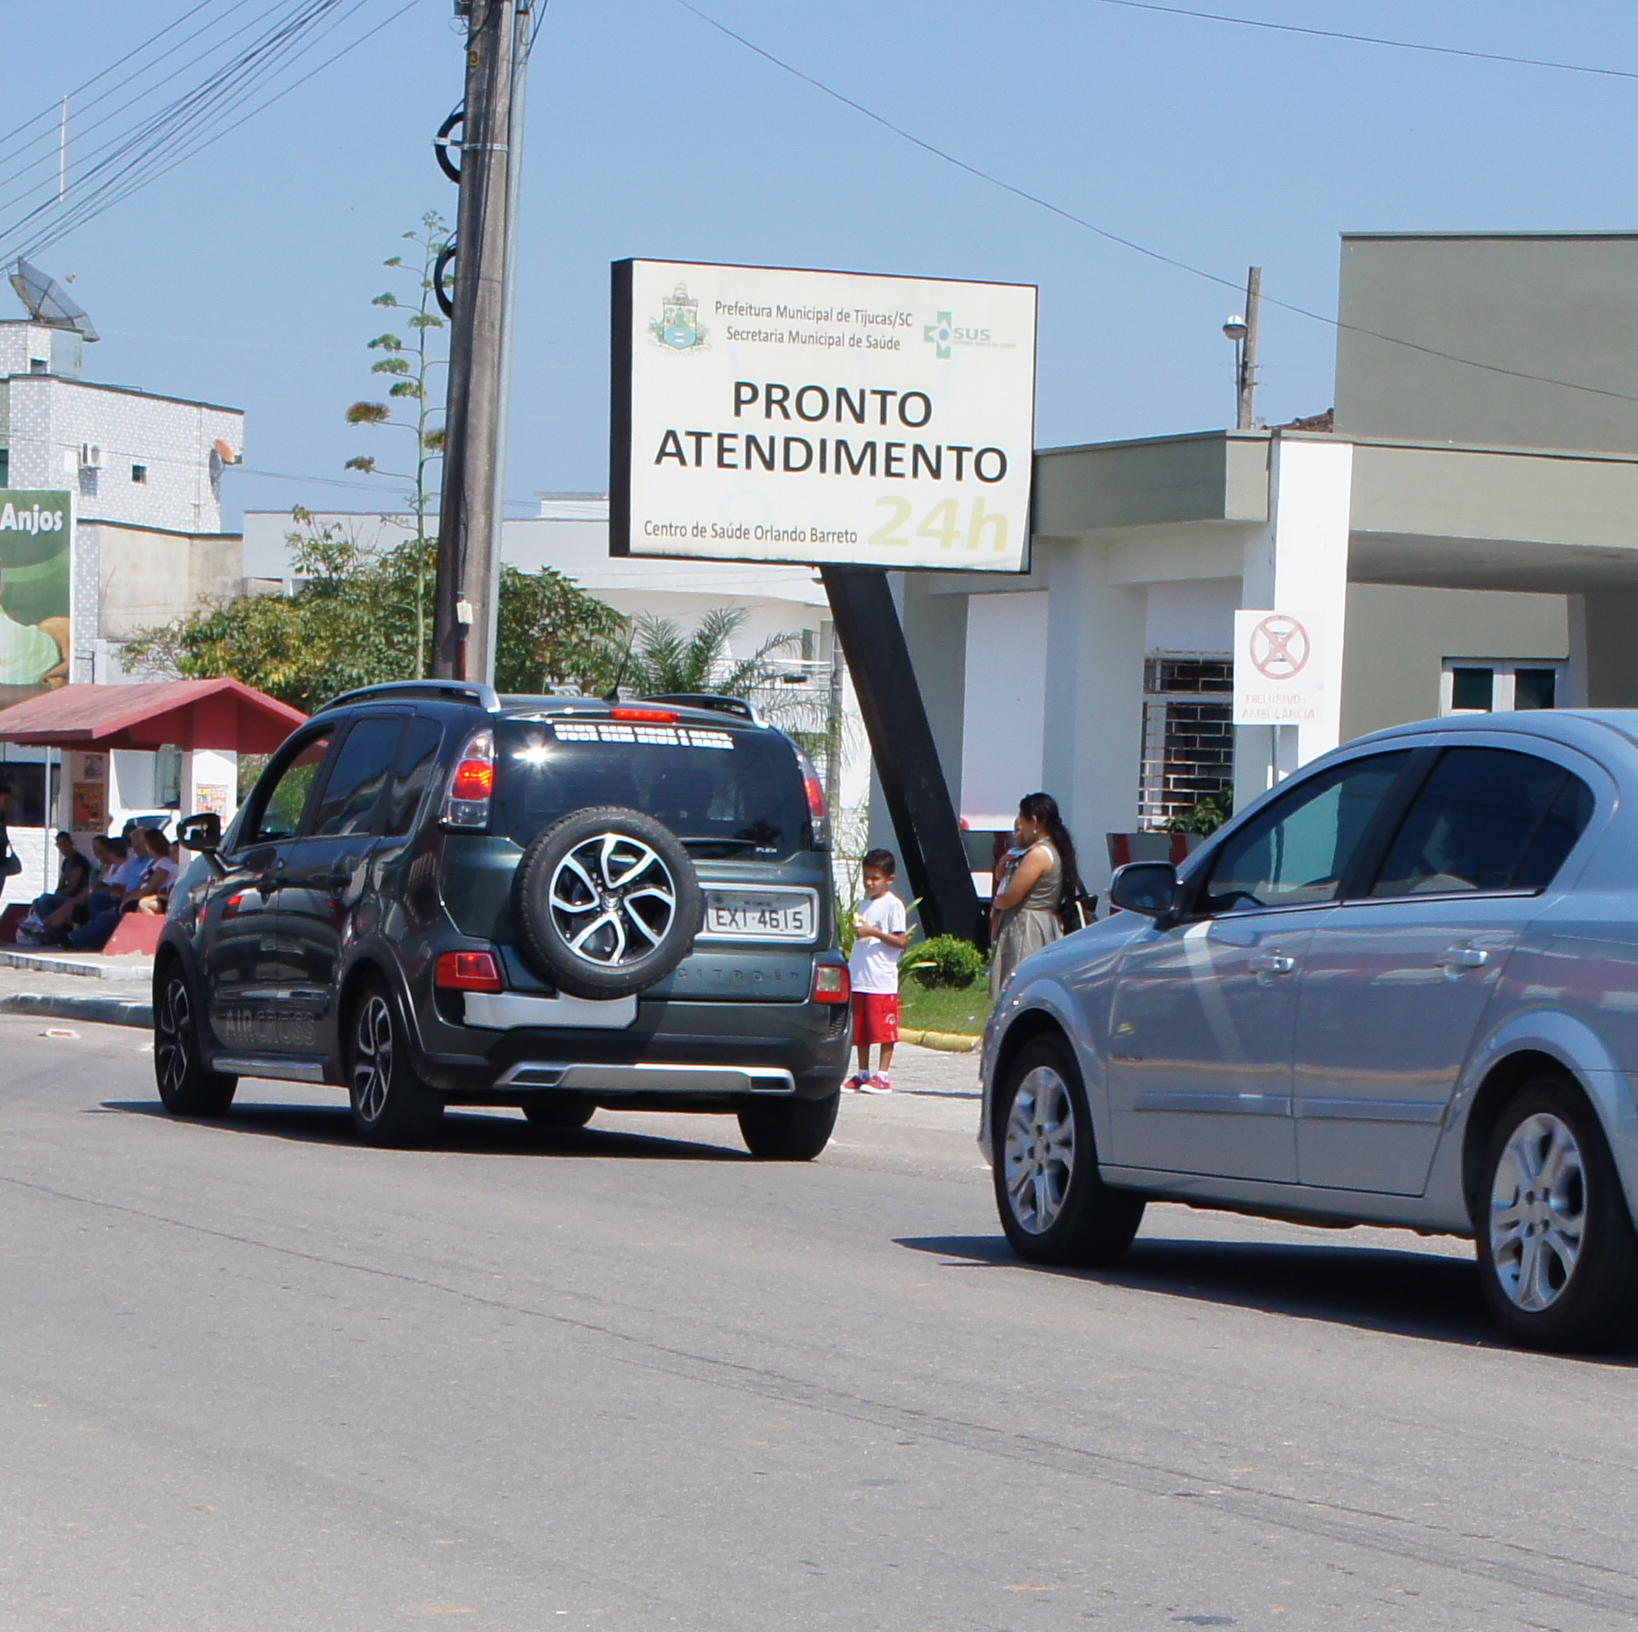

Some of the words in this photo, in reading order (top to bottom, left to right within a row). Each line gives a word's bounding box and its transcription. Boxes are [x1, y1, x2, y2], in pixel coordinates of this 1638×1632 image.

[715, 300, 772, 318] Prefeitura
[776, 304, 833, 324] Municipal
[836, 308, 851, 323] de
[854, 309, 913, 328] Tijucas/SC
[727, 326, 784, 344] Secretaria
[788, 329, 845, 350] Municipal
[848, 333, 863, 348] de
[865, 334, 900, 351] Saúde
[954, 327, 990, 341] SUS
[733, 380, 932, 428] PRONTO
[654, 428, 1008, 484] ATENDIMENTO
[644, 519, 688, 539] Centro
[691, 521, 708, 540] de
[710, 522, 750, 541] Saúde
[754, 524, 806, 543] Orlando
[810, 526, 858, 544] Barreto
[867, 494, 1009, 552] 24h
[1242, 707, 1315, 719] AMBULÂNCIA
